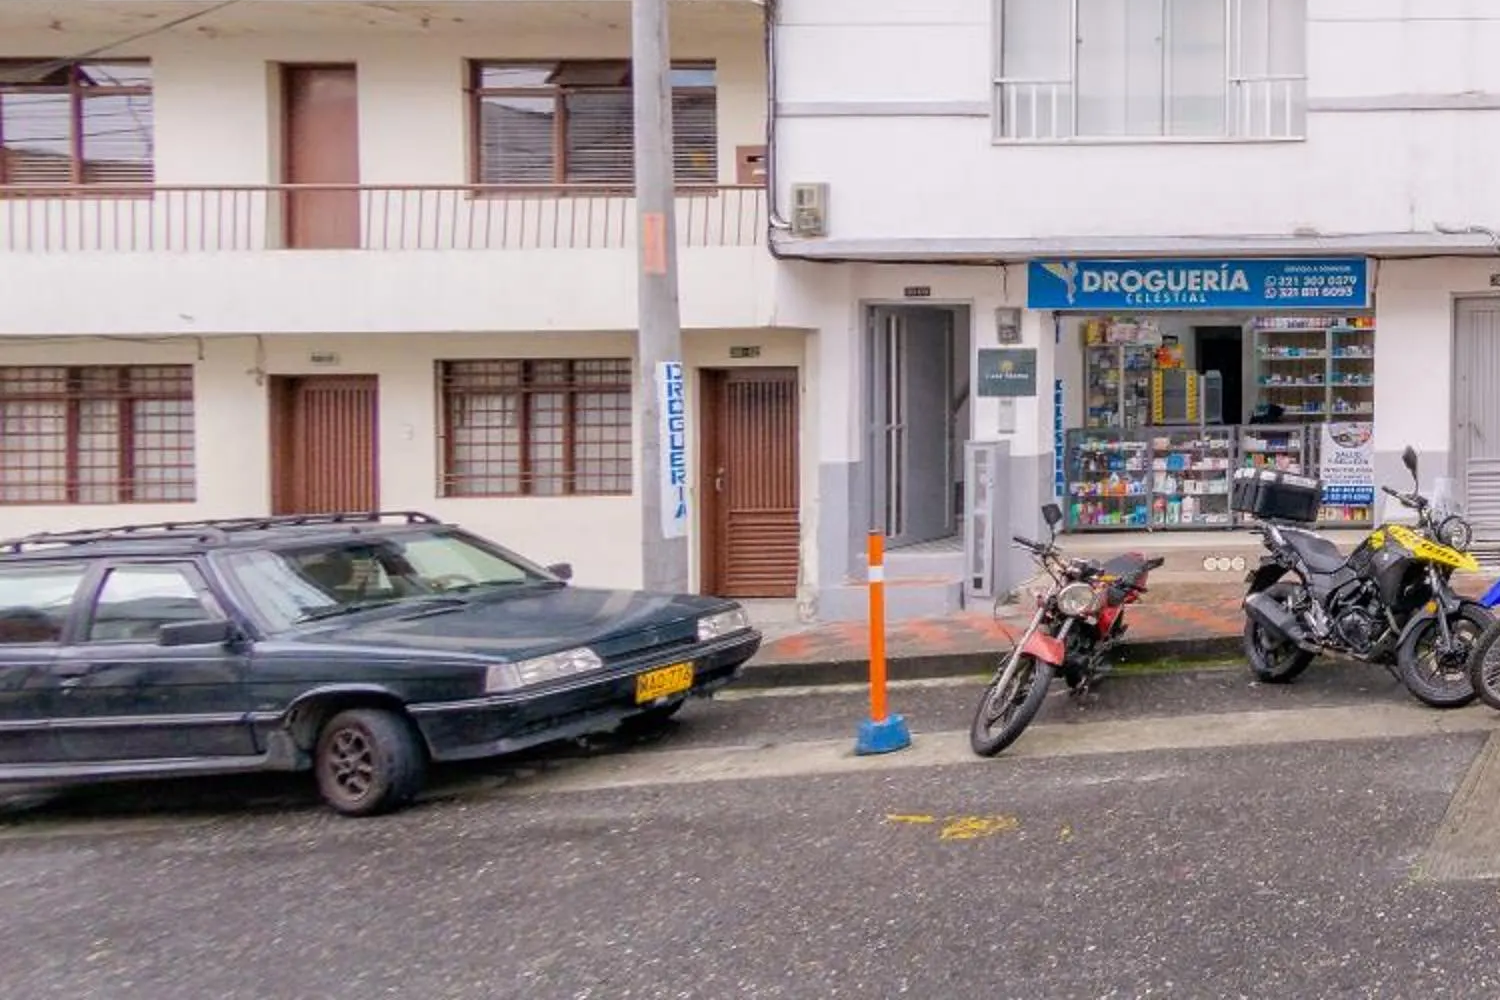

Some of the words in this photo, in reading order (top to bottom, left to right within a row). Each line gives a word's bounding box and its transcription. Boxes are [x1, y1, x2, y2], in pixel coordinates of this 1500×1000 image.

[1082, 264, 1249, 292] DROGUERÍA
[1125, 293, 1206, 304] CELESTIAL
[666, 364, 687, 519] DROGUERIA
